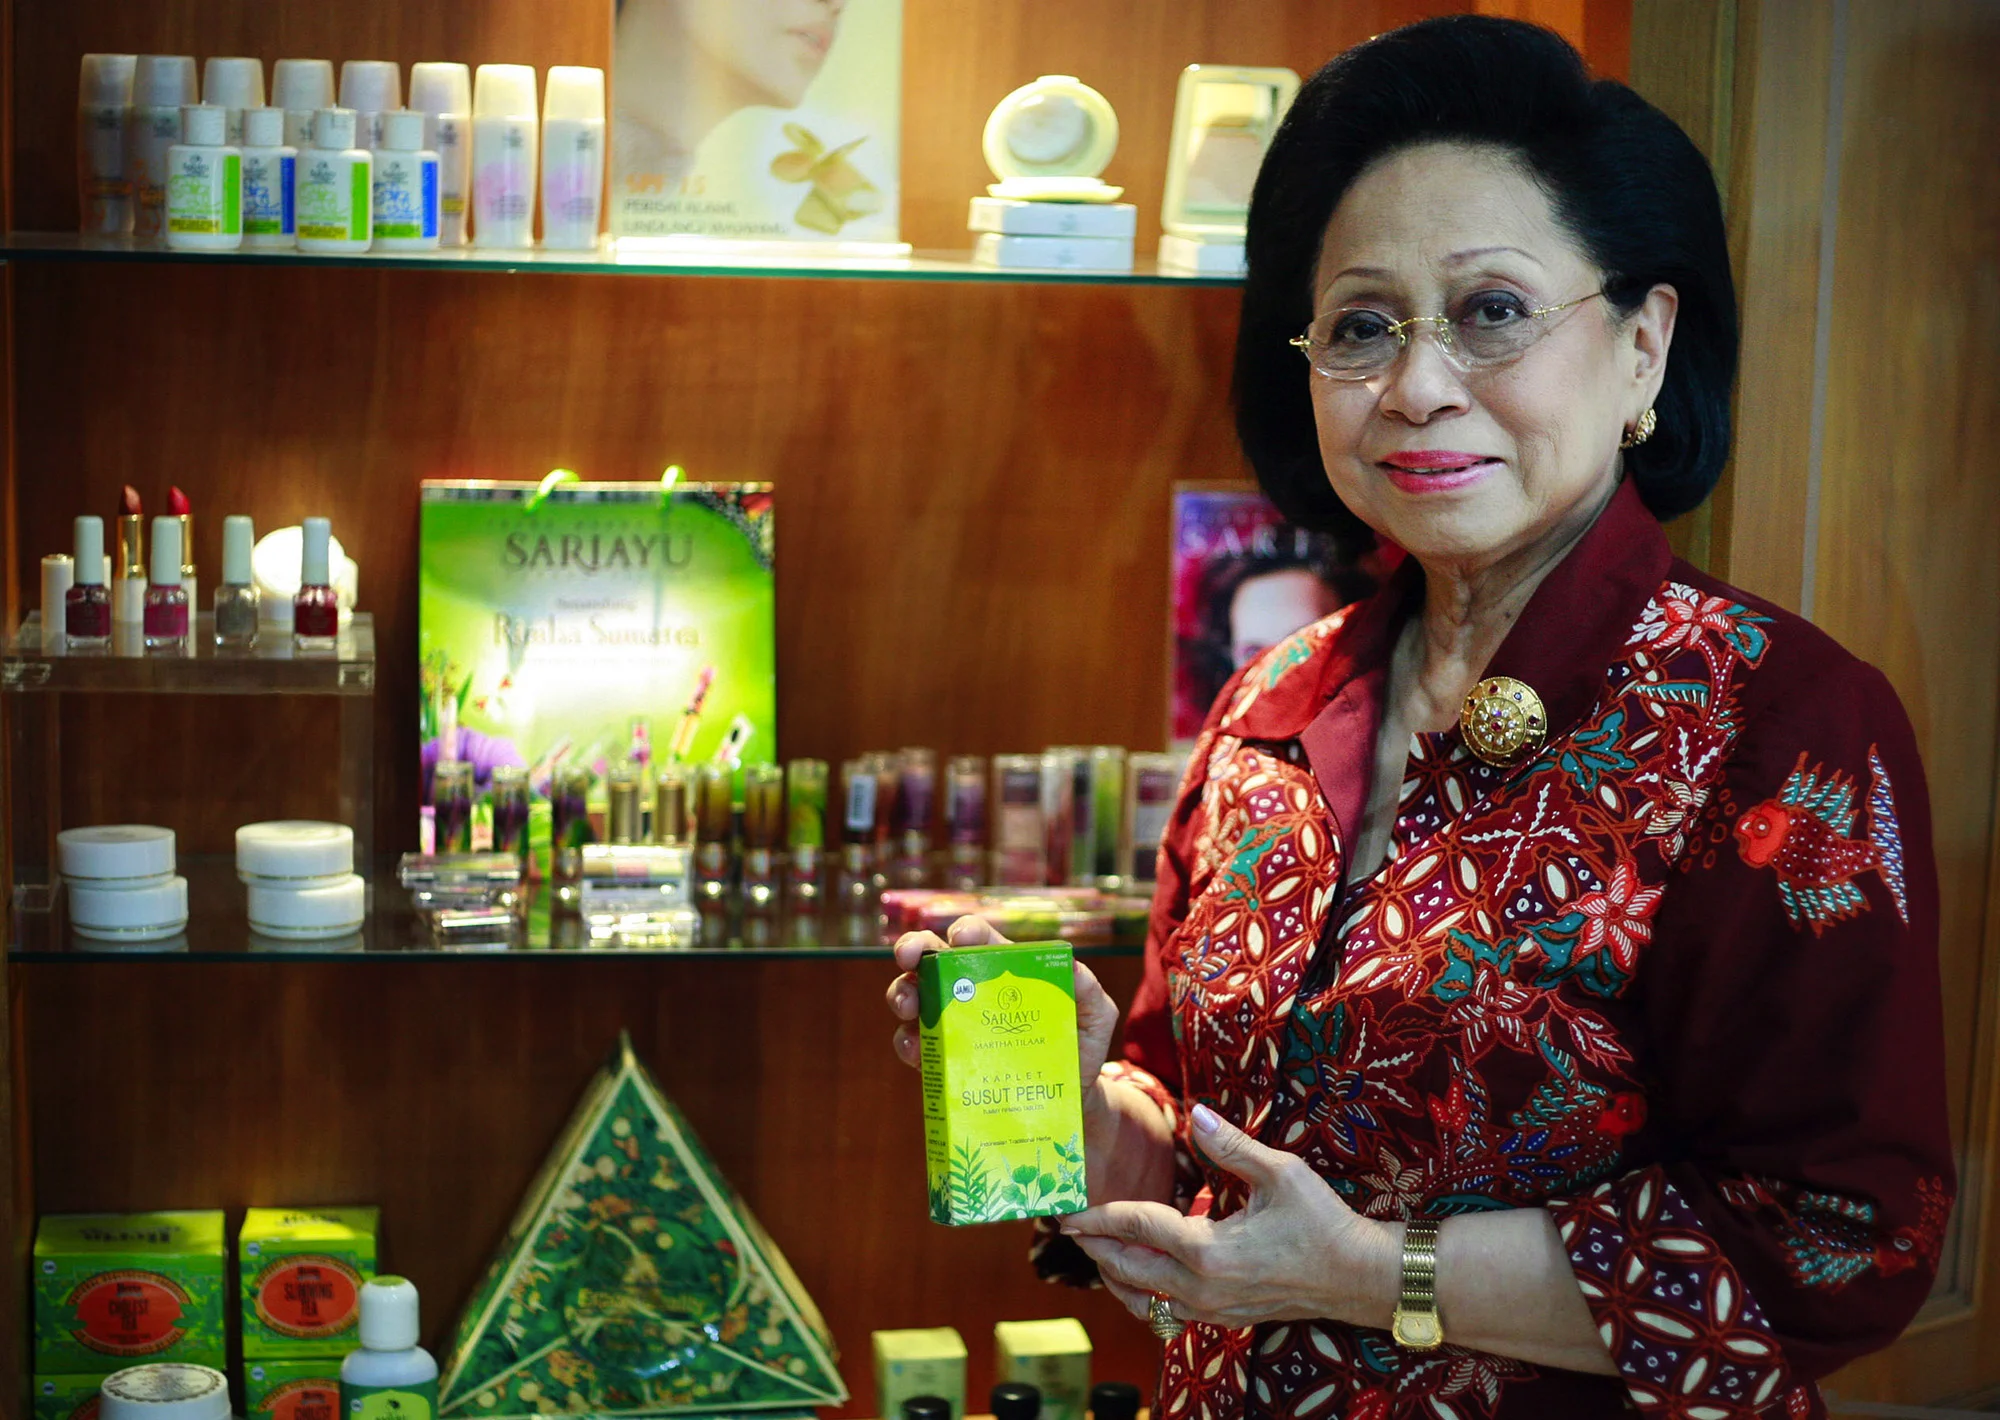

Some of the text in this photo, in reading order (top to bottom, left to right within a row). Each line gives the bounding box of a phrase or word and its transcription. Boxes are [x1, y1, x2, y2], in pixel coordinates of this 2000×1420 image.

[503, 532, 694, 575] SARIAYU
[955, 984, 973, 995] JAMU
[981, 1009, 1041, 1027] SARIAYU
[974, 1037, 1046, 1050] MARTHA TILAAR
[982, 1071, 1043, 1083] KAPLET
[962, 1083, 1064, 1107] SUSUT PERUT
